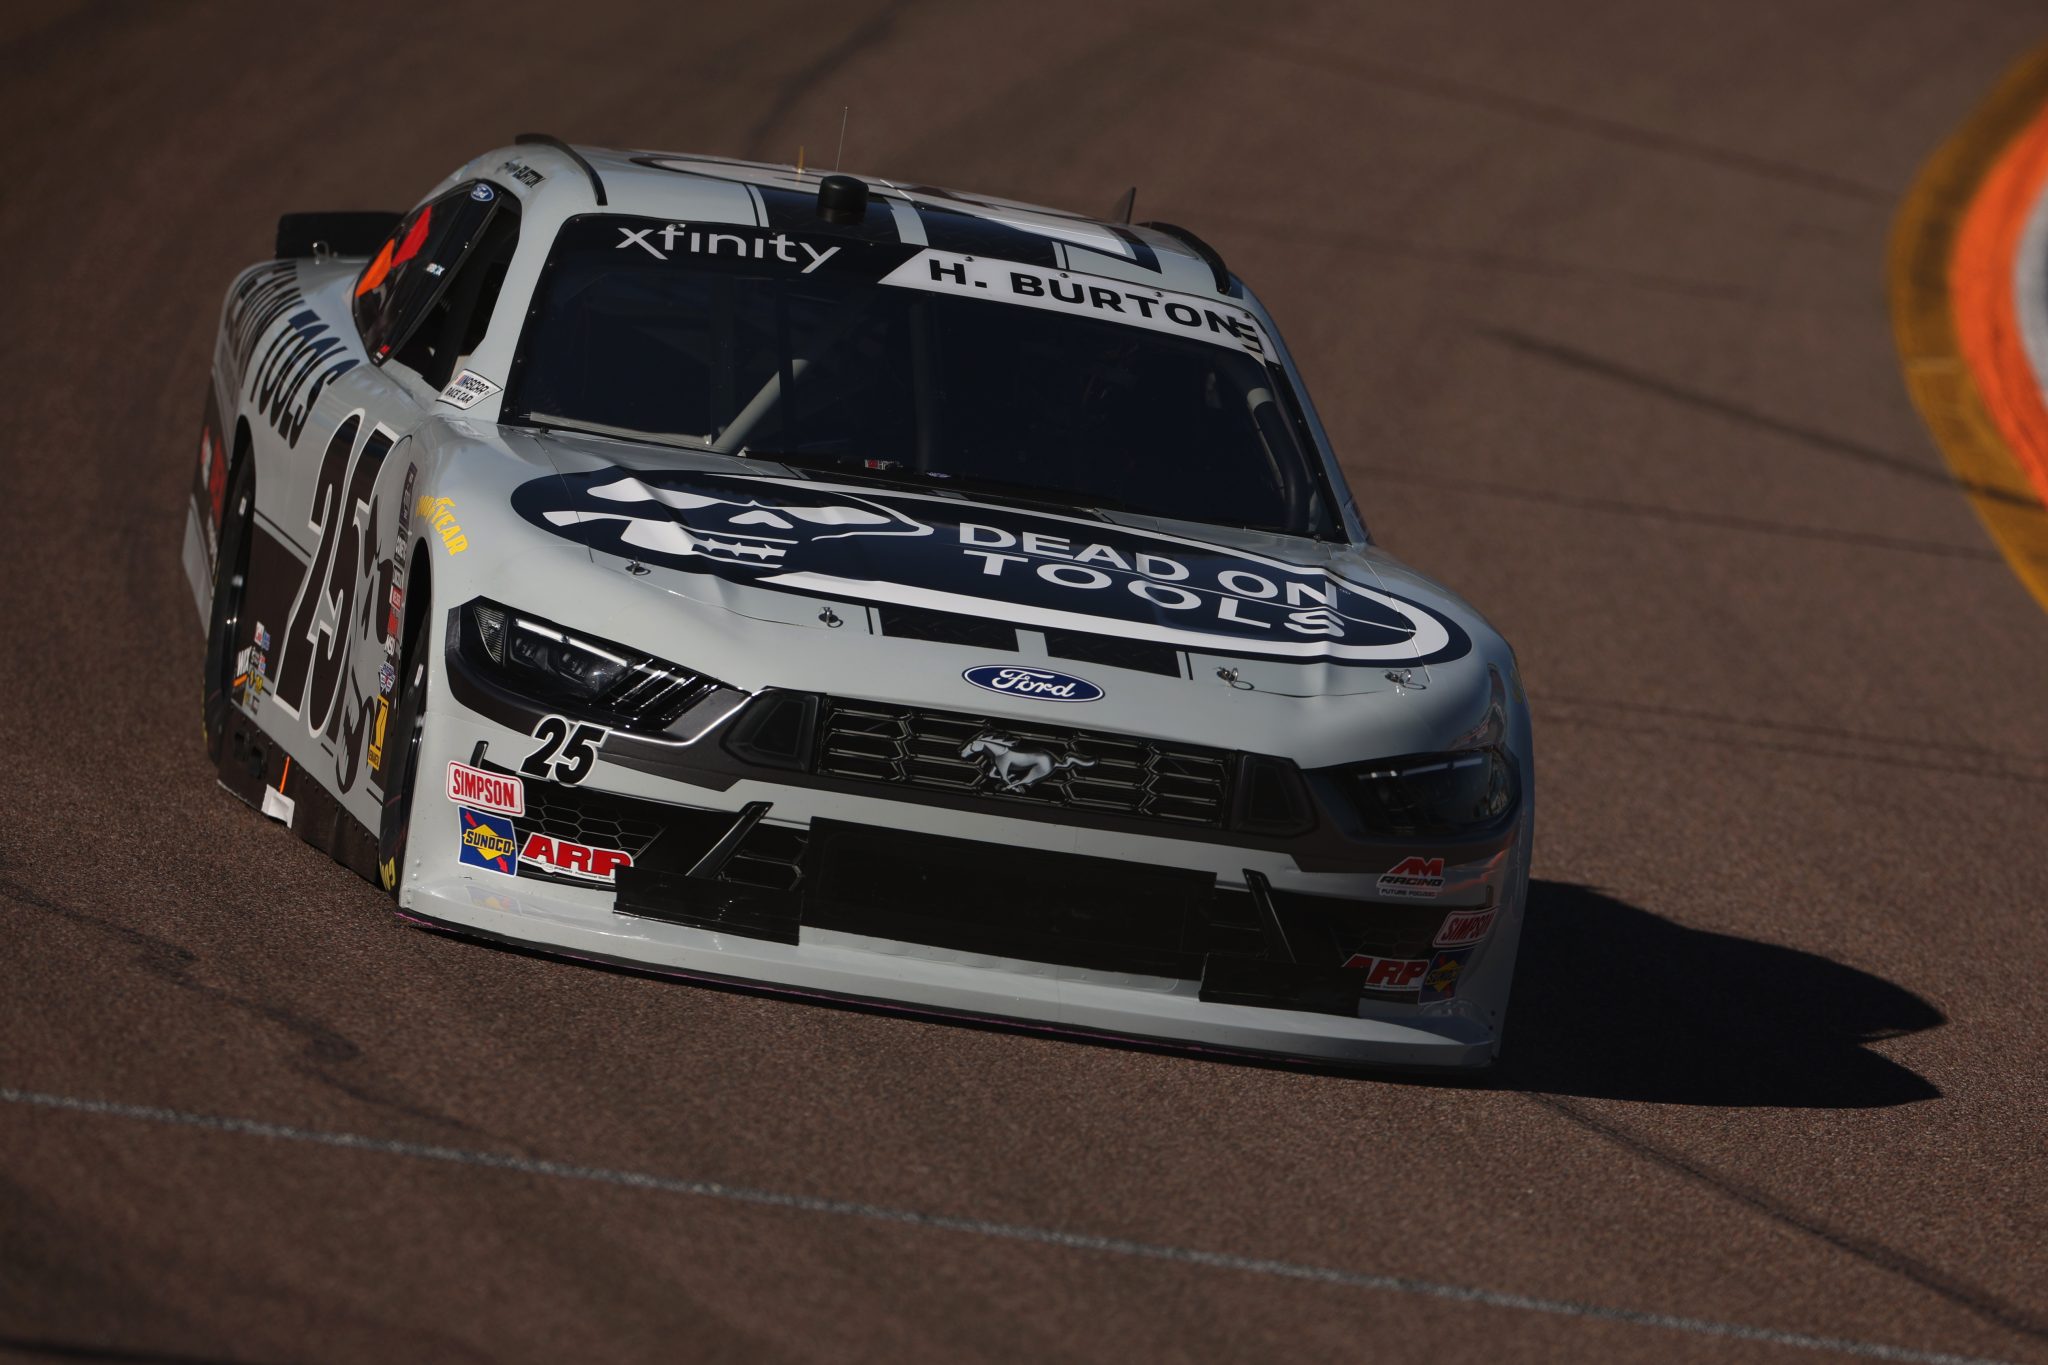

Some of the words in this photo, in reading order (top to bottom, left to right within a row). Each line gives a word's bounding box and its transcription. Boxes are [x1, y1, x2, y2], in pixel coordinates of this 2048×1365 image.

[615, 223, 841, 273] xfinity
[929, 259, 986, 289] H.
[1009, 272, 1241, 338] BURTON
[250, 309, 360, 450] TOOLS
[458, 391, 474, 404] CAR
[273, 408, 400, 738] 25
[959, 522, 1190, 581] DEAD
[1217, 570, 1338, 609] ON
[963, 549, 1345, 637] TOOLS
[991, 668, 1076, 698] Ford
[518, 715, 611, 786] 25
[453, 768, 515, 808] SIMPSON
[465, 831, 513, 854] SUNOCO
[1380, 876, 1443, 886] RACING
[1388, 857, 1443, 877] AM
[1381, 888, 1407, 896] FUTURE
